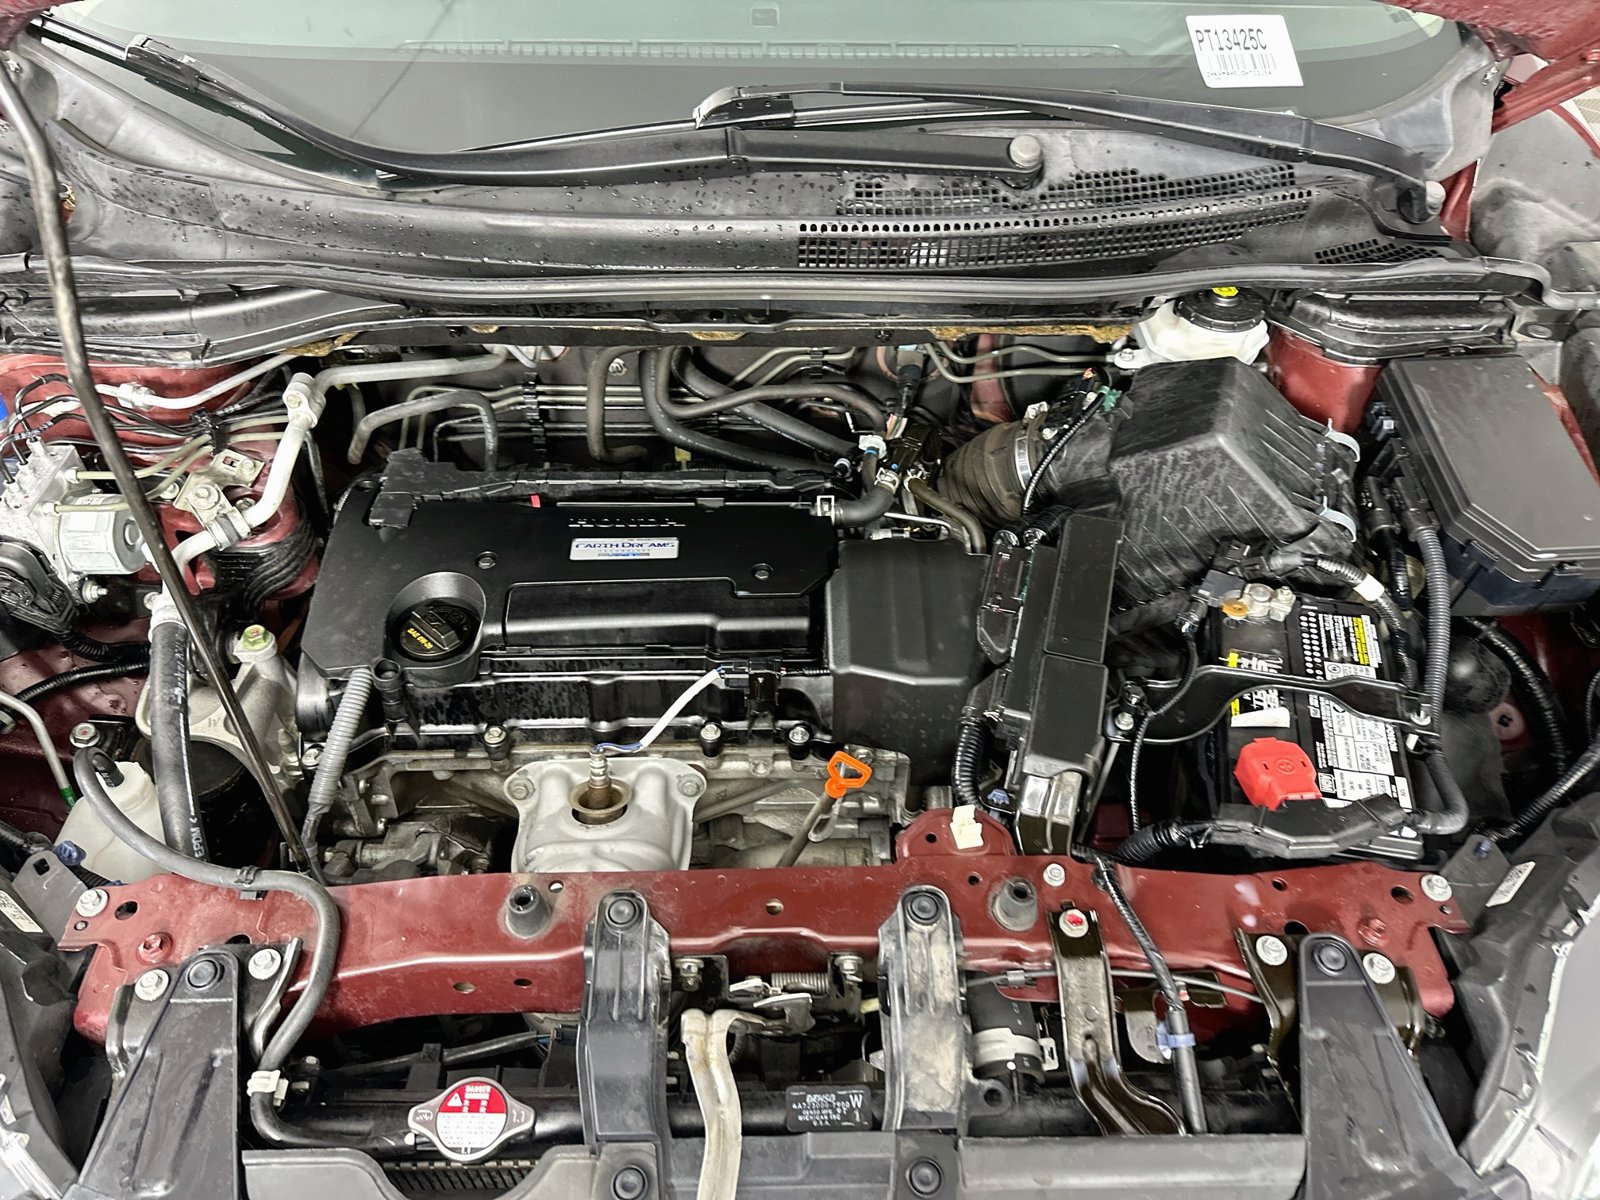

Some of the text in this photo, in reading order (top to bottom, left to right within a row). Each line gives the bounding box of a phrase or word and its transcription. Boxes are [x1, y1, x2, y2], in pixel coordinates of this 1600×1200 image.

[1195, 28, 1267, 51] PT13425C
[806, 1093, 863, 1109] DENSO W
